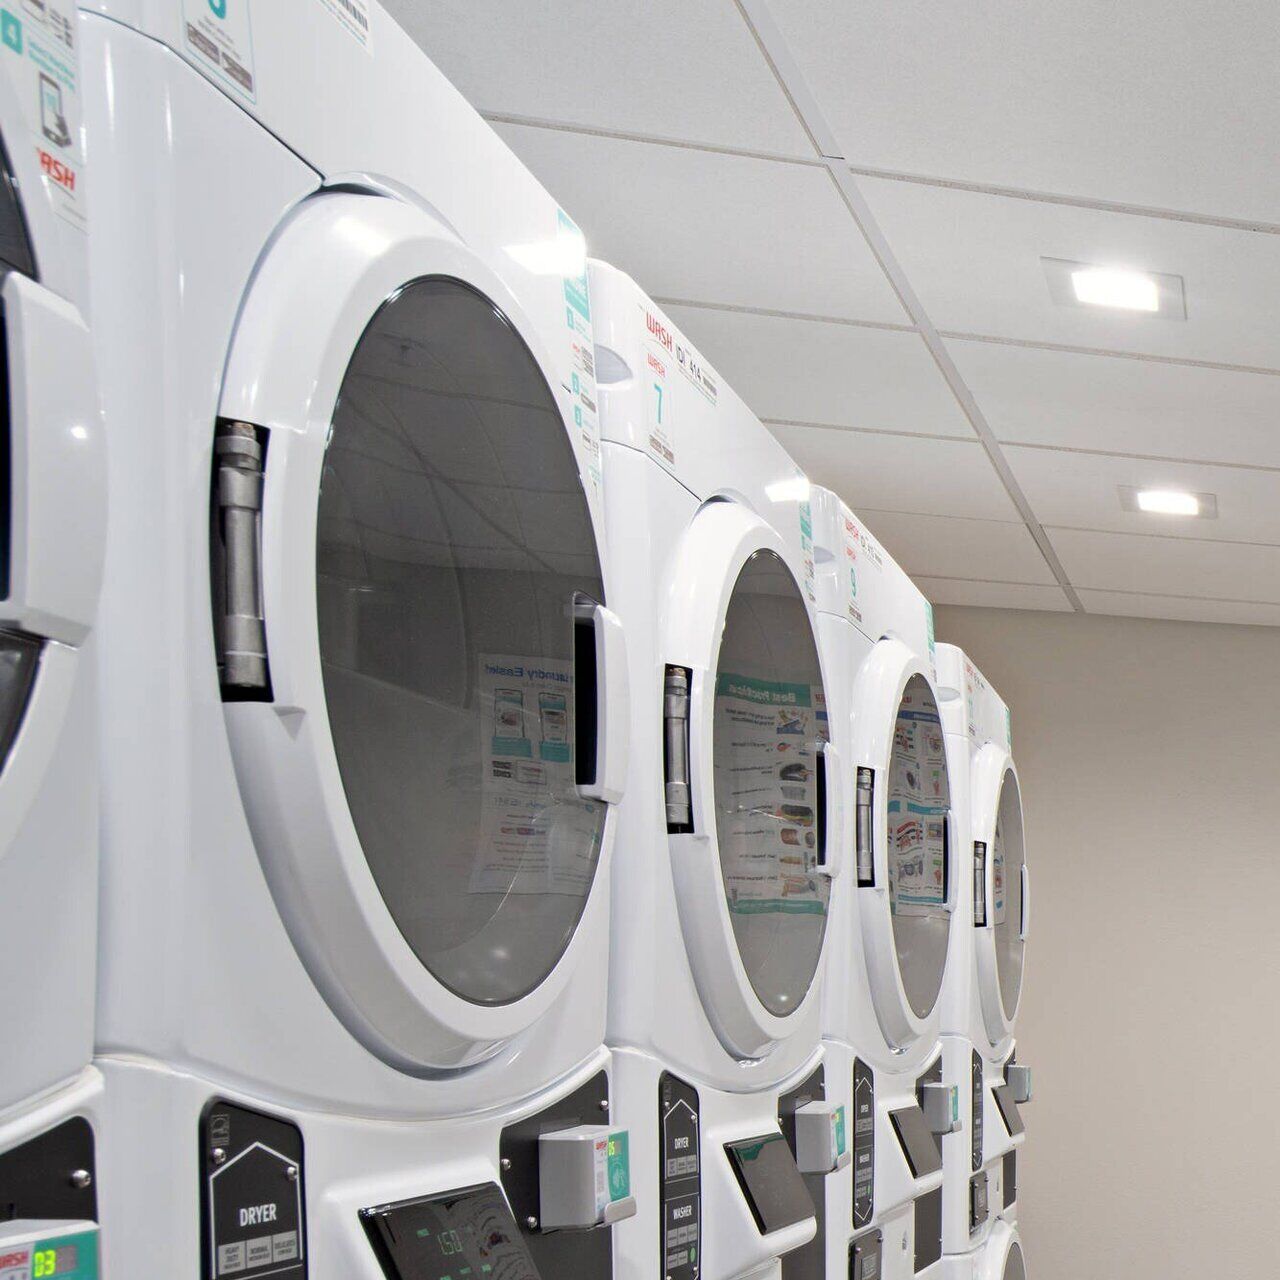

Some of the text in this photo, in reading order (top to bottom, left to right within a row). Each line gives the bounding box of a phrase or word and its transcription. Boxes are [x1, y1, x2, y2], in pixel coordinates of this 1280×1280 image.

[654, 383, 663, 424] 7
[240, 1203, 277, 1227] DRYER
[673, 1205, 692, 1220] WASHER
